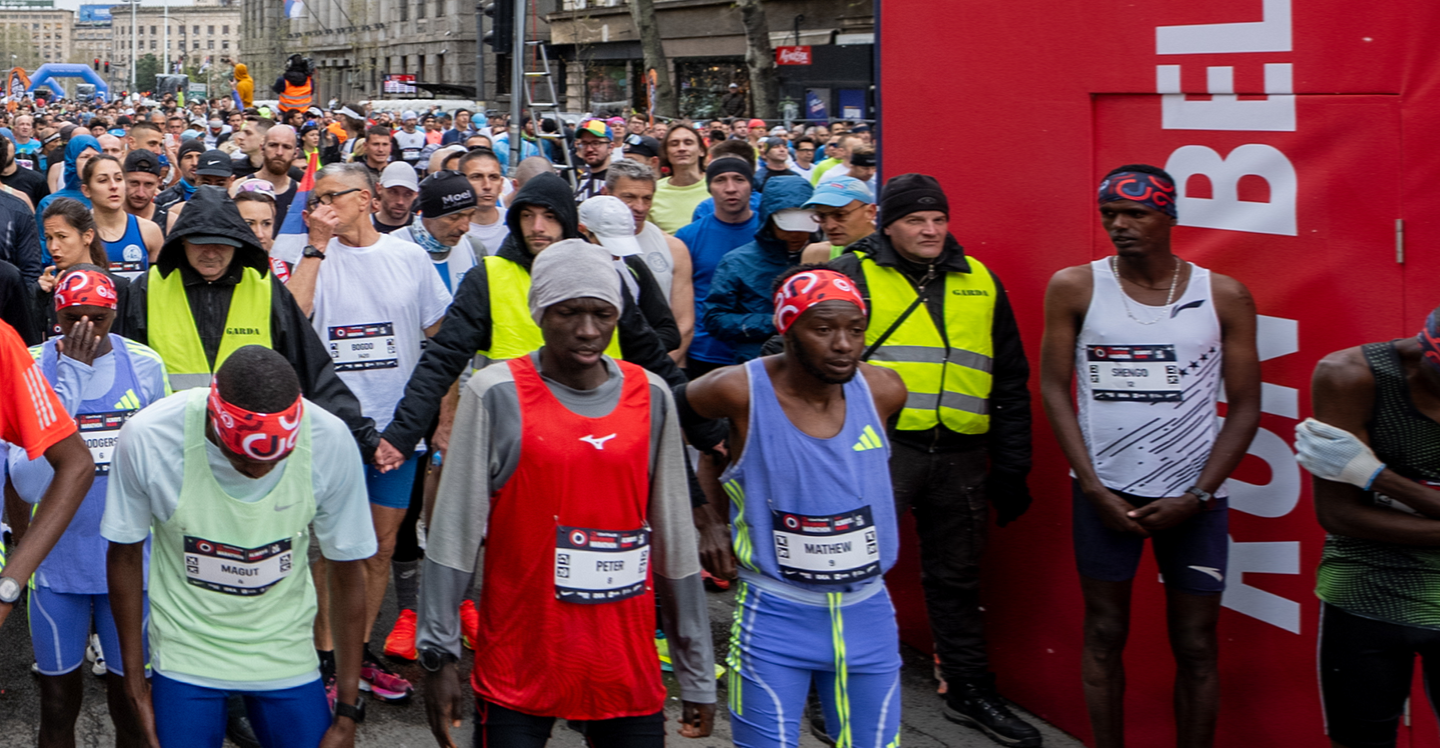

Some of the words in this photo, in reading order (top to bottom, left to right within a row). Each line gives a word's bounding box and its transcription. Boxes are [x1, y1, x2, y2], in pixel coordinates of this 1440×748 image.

[1156, 0, 1298, 236] BEL
[226, 327, 260, 335] GARDA
[85, 437, 118, 448] ODGERS
[804, 541, 852, 554] MATHEW
[221, 564, 259, 576] MAGUT
[596, 560, 624, 572] PETER
